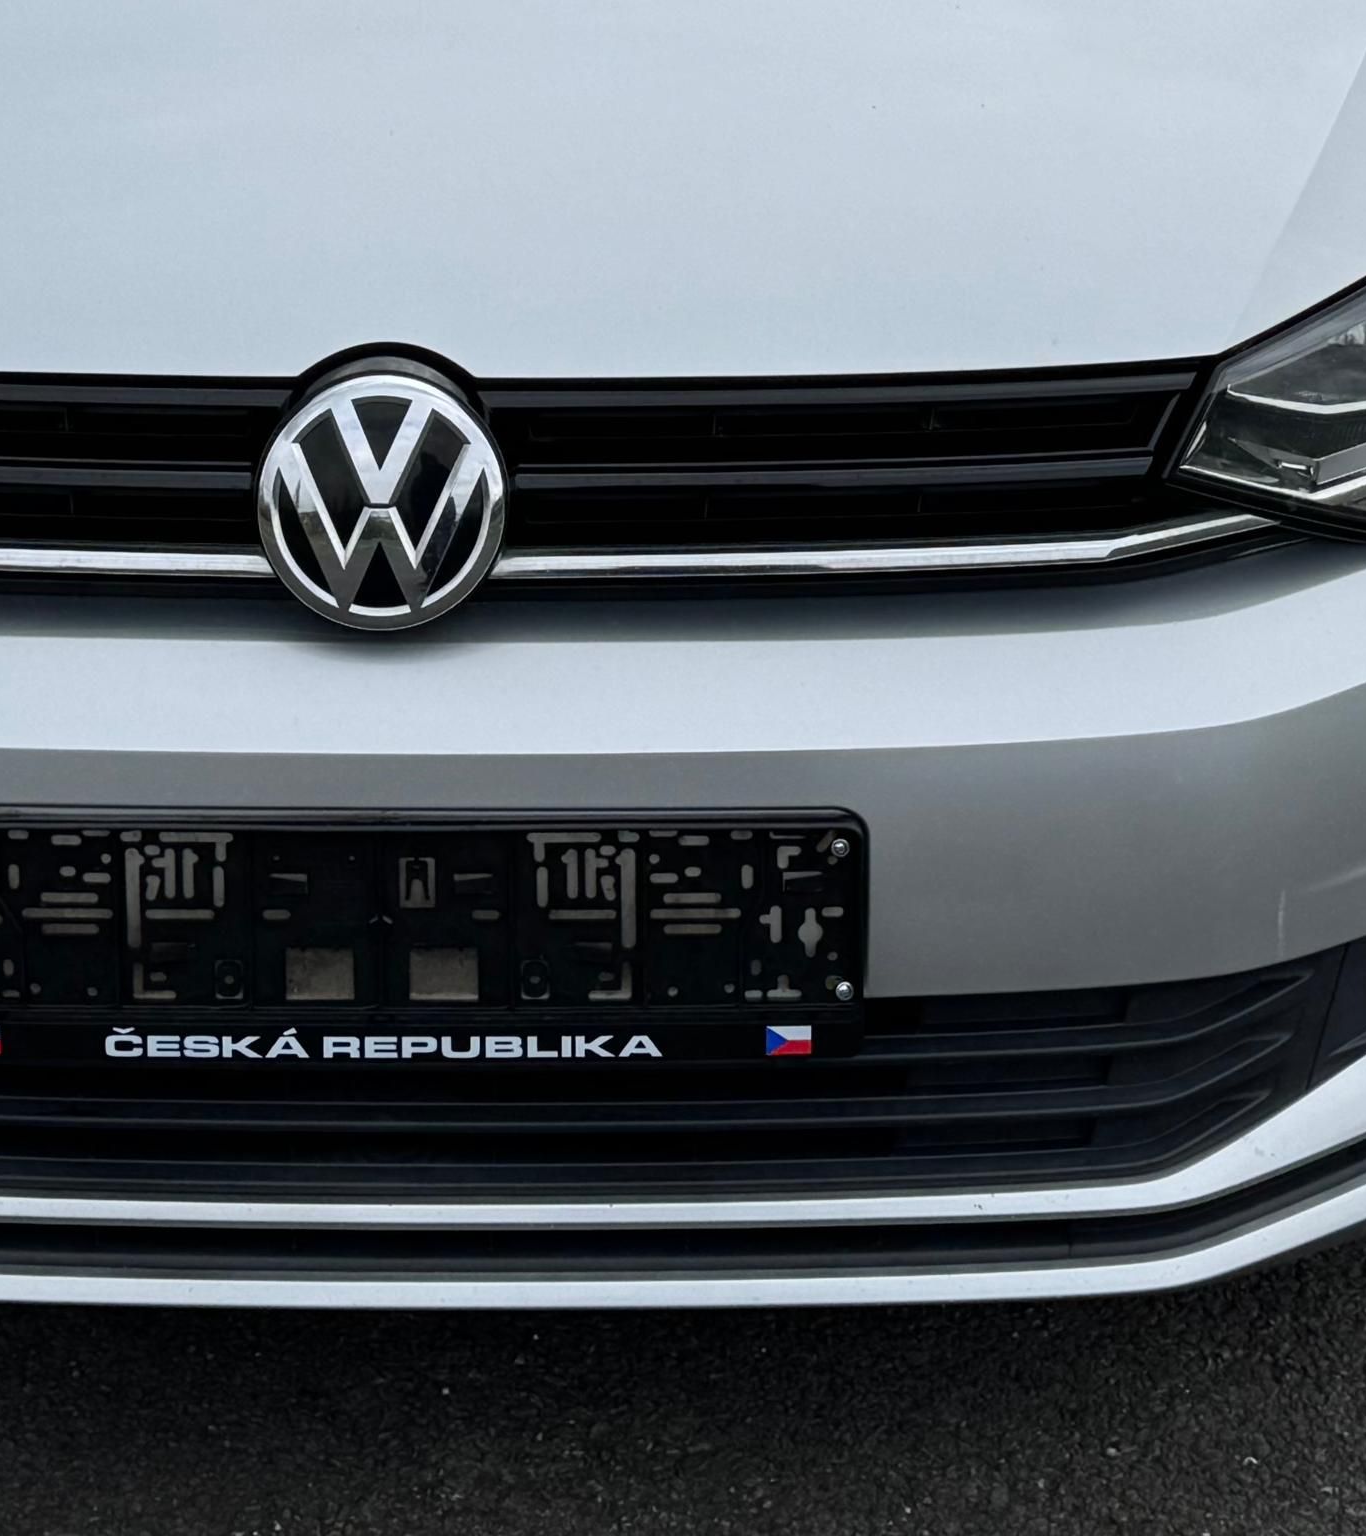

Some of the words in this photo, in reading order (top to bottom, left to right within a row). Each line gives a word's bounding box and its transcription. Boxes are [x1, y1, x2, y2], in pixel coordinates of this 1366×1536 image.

[261, 378, 503, 628] VW
[104, 1027, 310, 1058] ČESKÁ
[322, 1035, 663, 1059] REPUBLIKA
